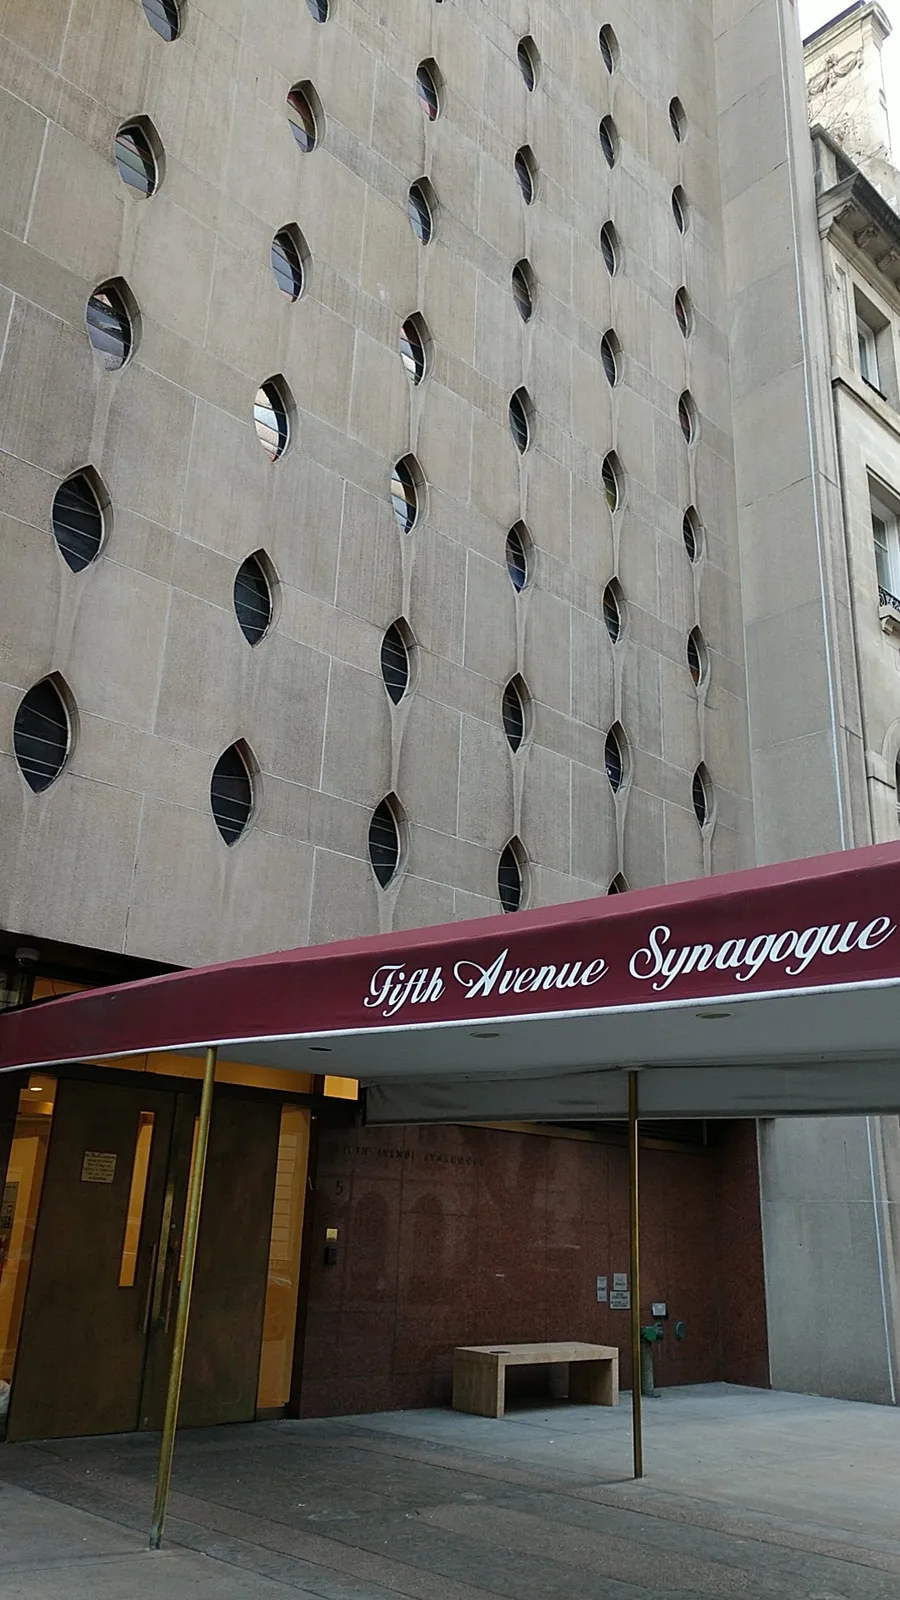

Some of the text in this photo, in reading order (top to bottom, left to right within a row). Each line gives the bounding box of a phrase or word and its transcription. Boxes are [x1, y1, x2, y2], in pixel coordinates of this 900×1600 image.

[364, 915, 897, 1018] Fifth Avenue Synagogue
